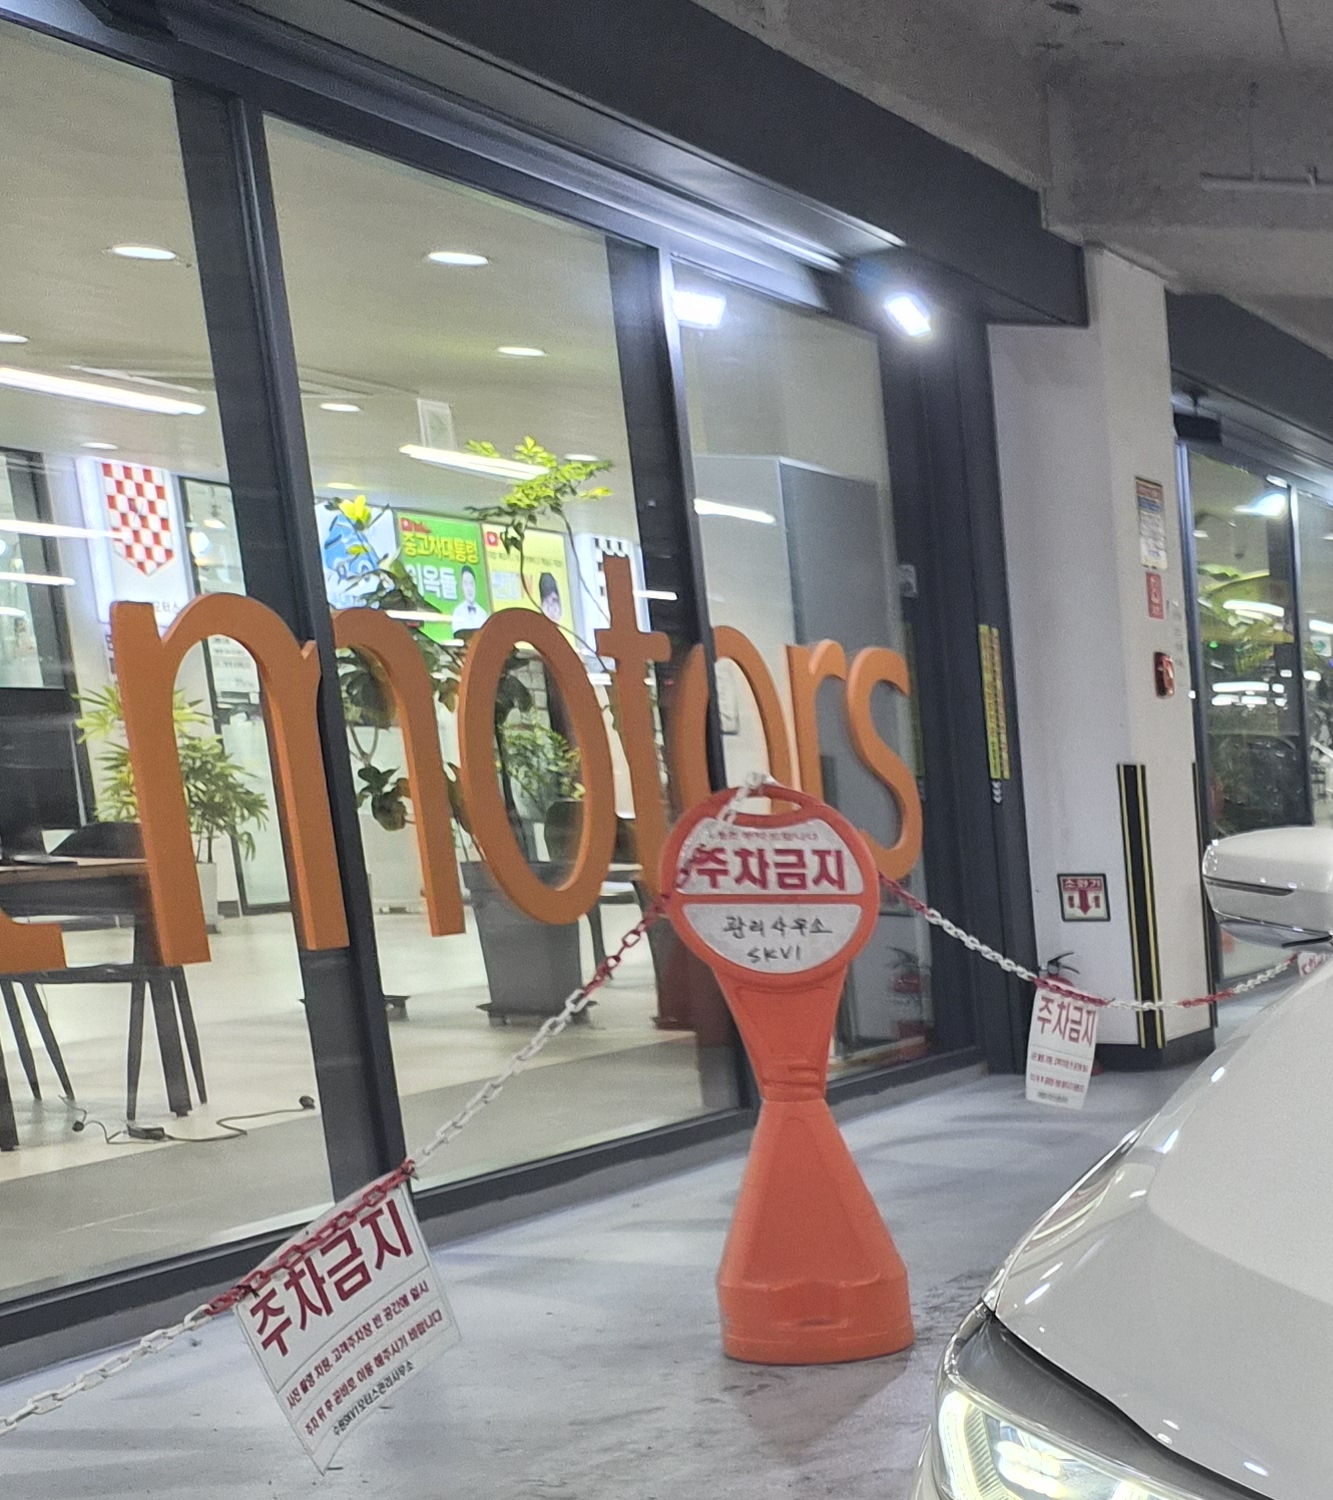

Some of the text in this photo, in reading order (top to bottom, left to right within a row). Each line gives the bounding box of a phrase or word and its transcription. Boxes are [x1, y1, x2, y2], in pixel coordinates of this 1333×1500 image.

[109, 553, 923, 965] motors
[693, 846, 847, 891] 주차금지
[1036, 995, 1096, 1048] 주차금지
[249, 1198, 414, 1357] 주차금지
